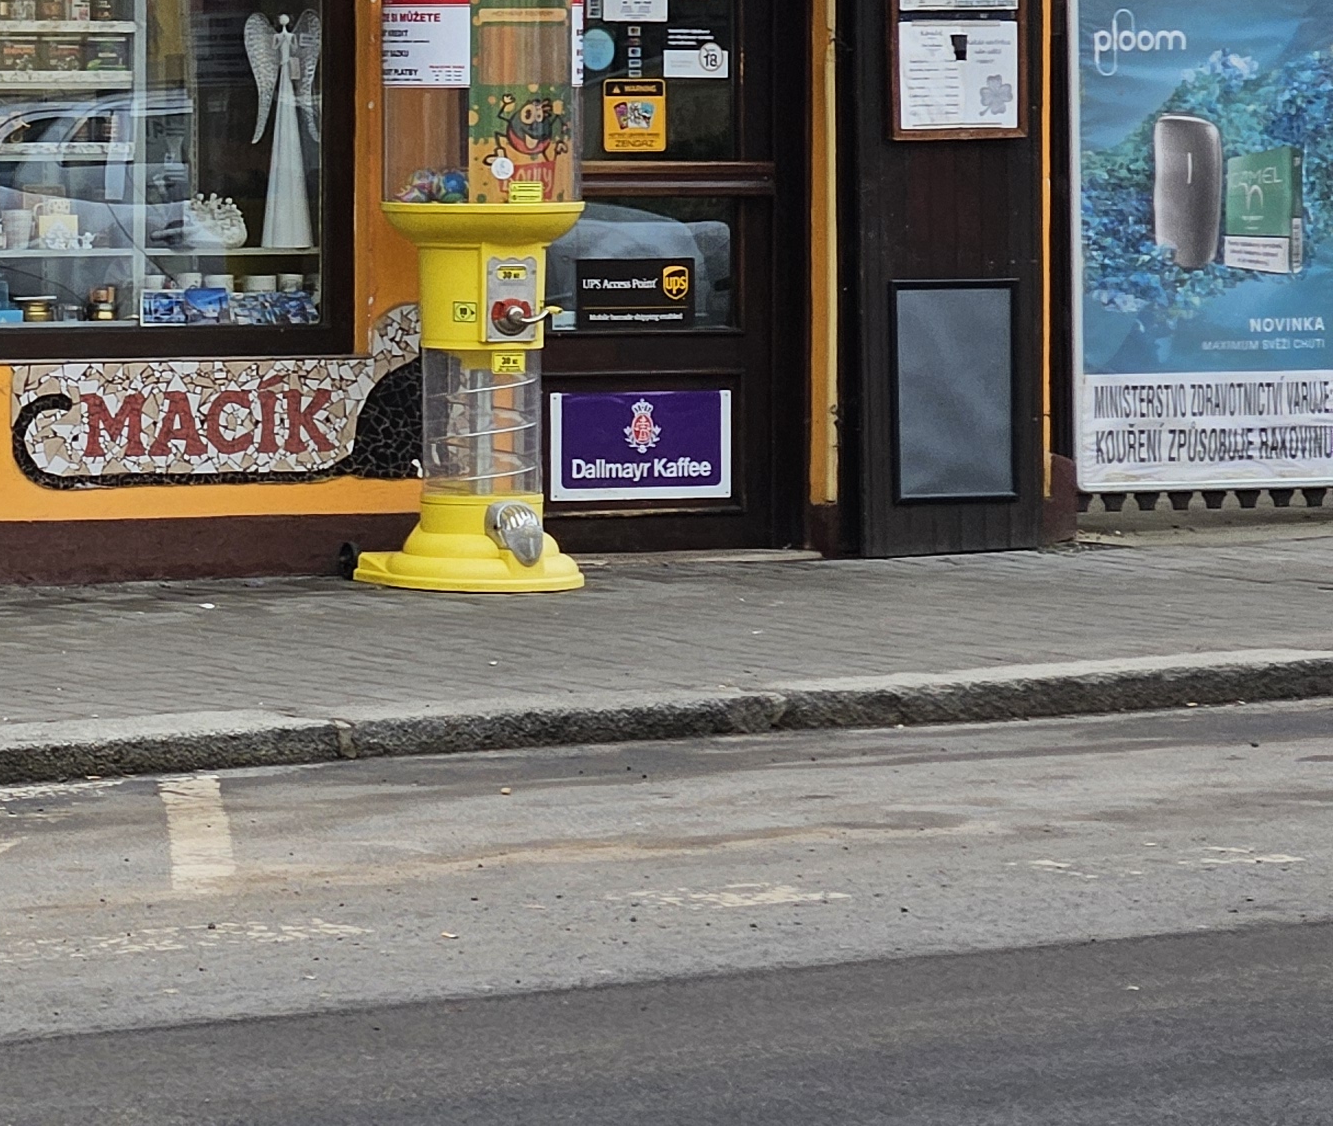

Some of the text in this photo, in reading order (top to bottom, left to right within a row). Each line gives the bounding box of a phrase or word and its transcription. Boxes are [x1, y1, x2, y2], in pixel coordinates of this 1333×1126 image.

[1093, 8, 1187, 76] ploom
[582, 278, 601, 289] UPS
[602, 279, 632, 289] Access
[665, 276, 686, 295] ups
[1249, 317, 1325, 332] NOVINKA
[1201, 340, 1259, 350] MAXIMUM
[1093, 383, 1186, 419] MINISTERSTVO
[1190, 376, 1283, 418] ZDRAVOTNICTVÍ
[80, 375, 336, 457] MACÍK
[1095, 421, 1333, 464] KOUŘENÍ ZPŮSOBUJE RAKOVINU
[571, 457, 712, 481] Dallmayr Kaffee
